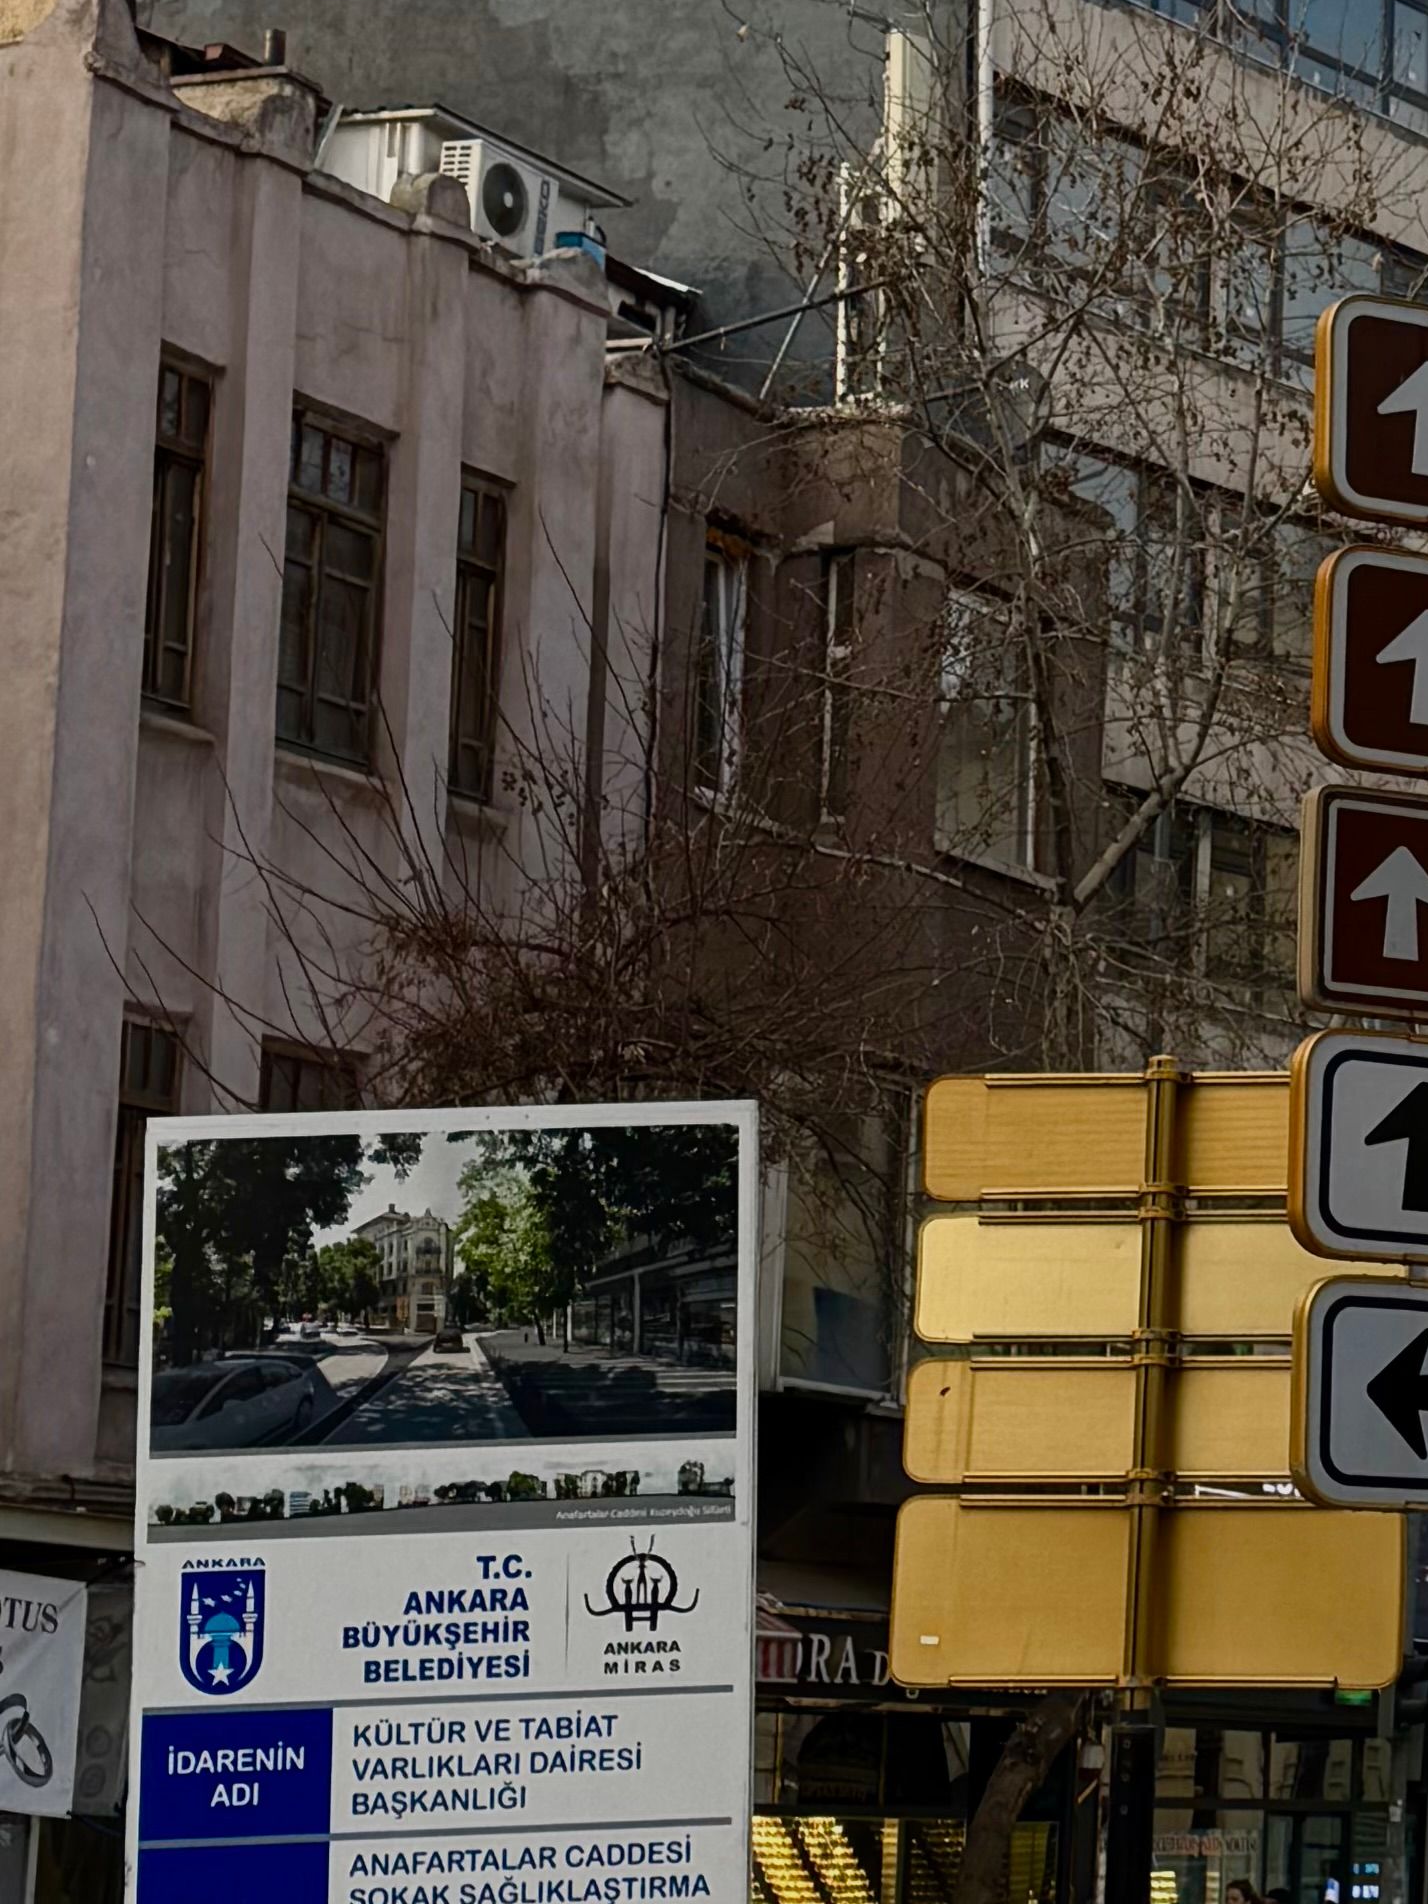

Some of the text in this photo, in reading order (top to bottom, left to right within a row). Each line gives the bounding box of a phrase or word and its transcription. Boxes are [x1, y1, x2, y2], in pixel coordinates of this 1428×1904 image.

[181, 1557, 266, 1569] ANKARA
[476, 1553, 532, 1581] T.C.
[404, 1587, 529, 1615] ANKARA
[342, 1615, 530, 1652] BÜYÜKŞEHİR
[603, 1640, 681, 1657] ANKARA
[363, 1651, 530, 1684] BELEDİYESİ
[603, 1658, 681, 1675] MİRAS
[796, 1633, 860, 1685] RA
[353, 1709, 618, 1748] KÜLTÜR VE TABİAT
[168, 1741, 306, 1776] İDARENİN
[352, 1741, 643, 1782] VARLIKLARI DAİRESİ
[210, 1783, 260, 1807] ADI
[351, 1781, 527, 1819] BAŞKANLIĞI
[348, 1834, 692, 1878] ANAFARTALAR CADDESİ
